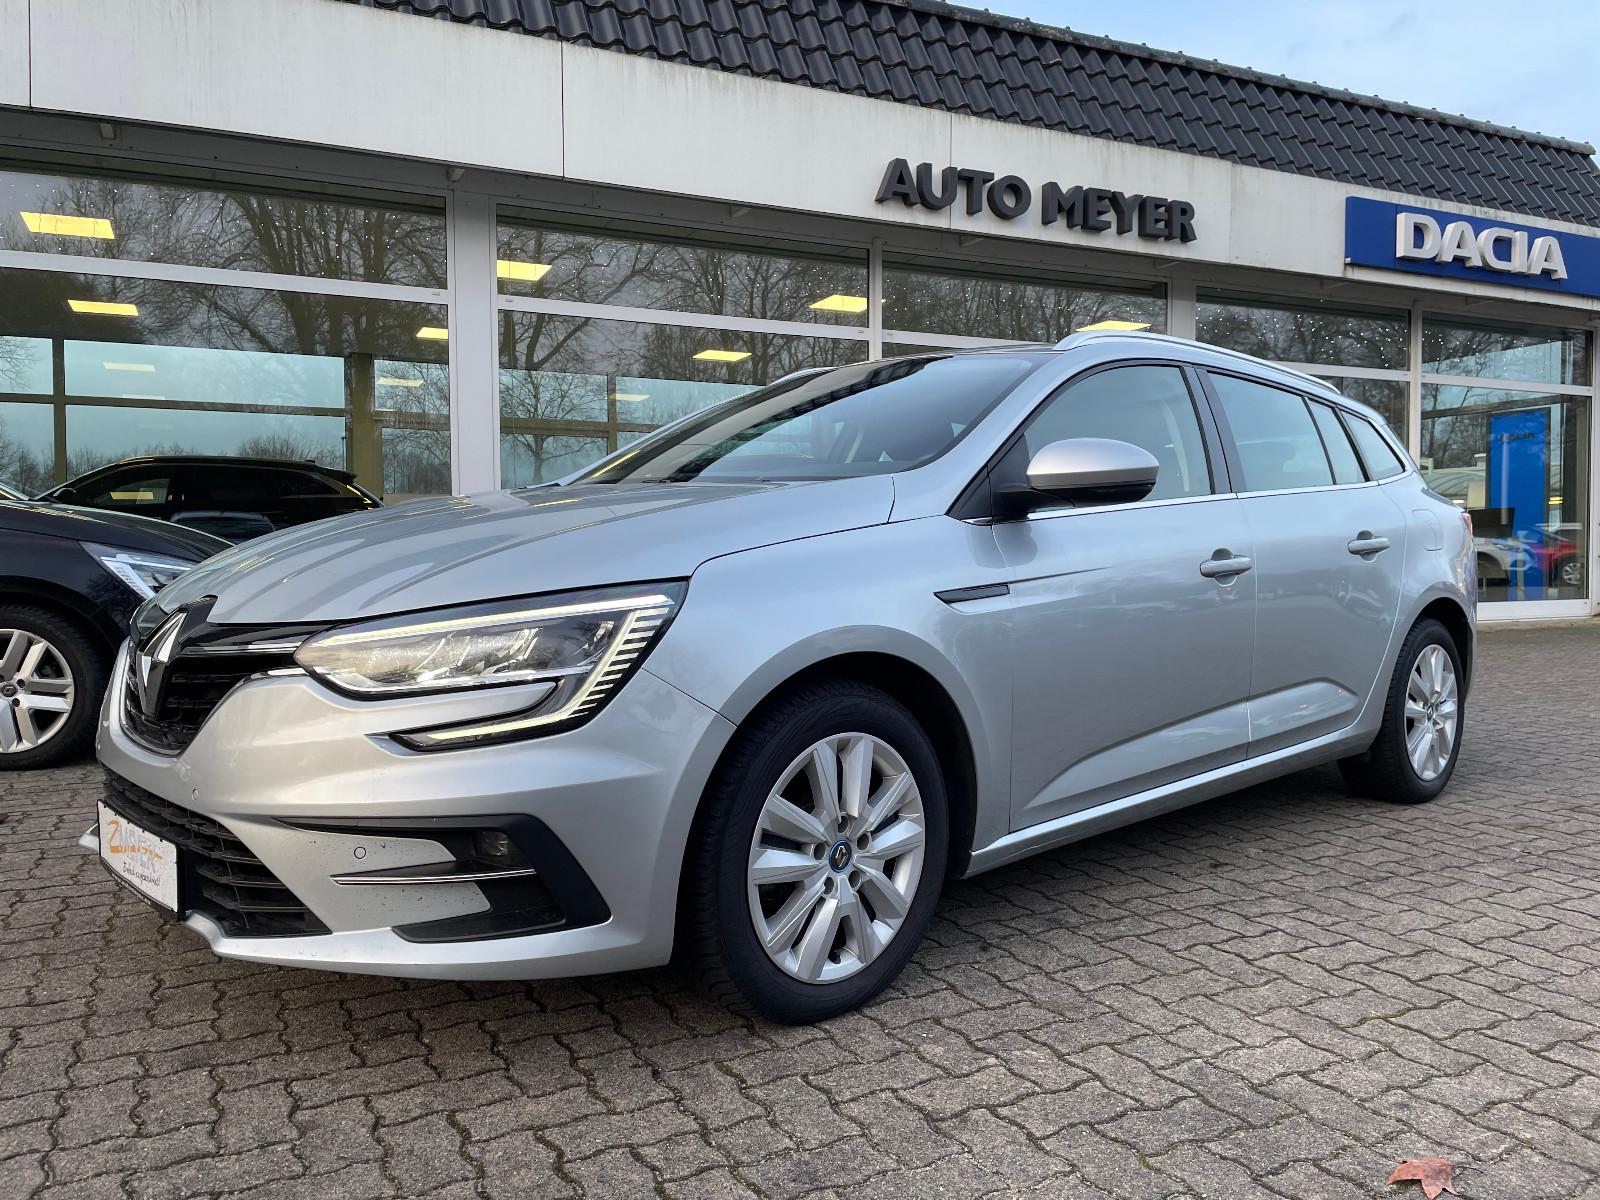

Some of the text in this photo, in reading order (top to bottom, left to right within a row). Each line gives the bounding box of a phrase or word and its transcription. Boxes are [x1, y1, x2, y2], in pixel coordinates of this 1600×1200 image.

[875, 157, 1197, 243] AUTO MEYER
[1396, 212, 1568, 279] DACIA
